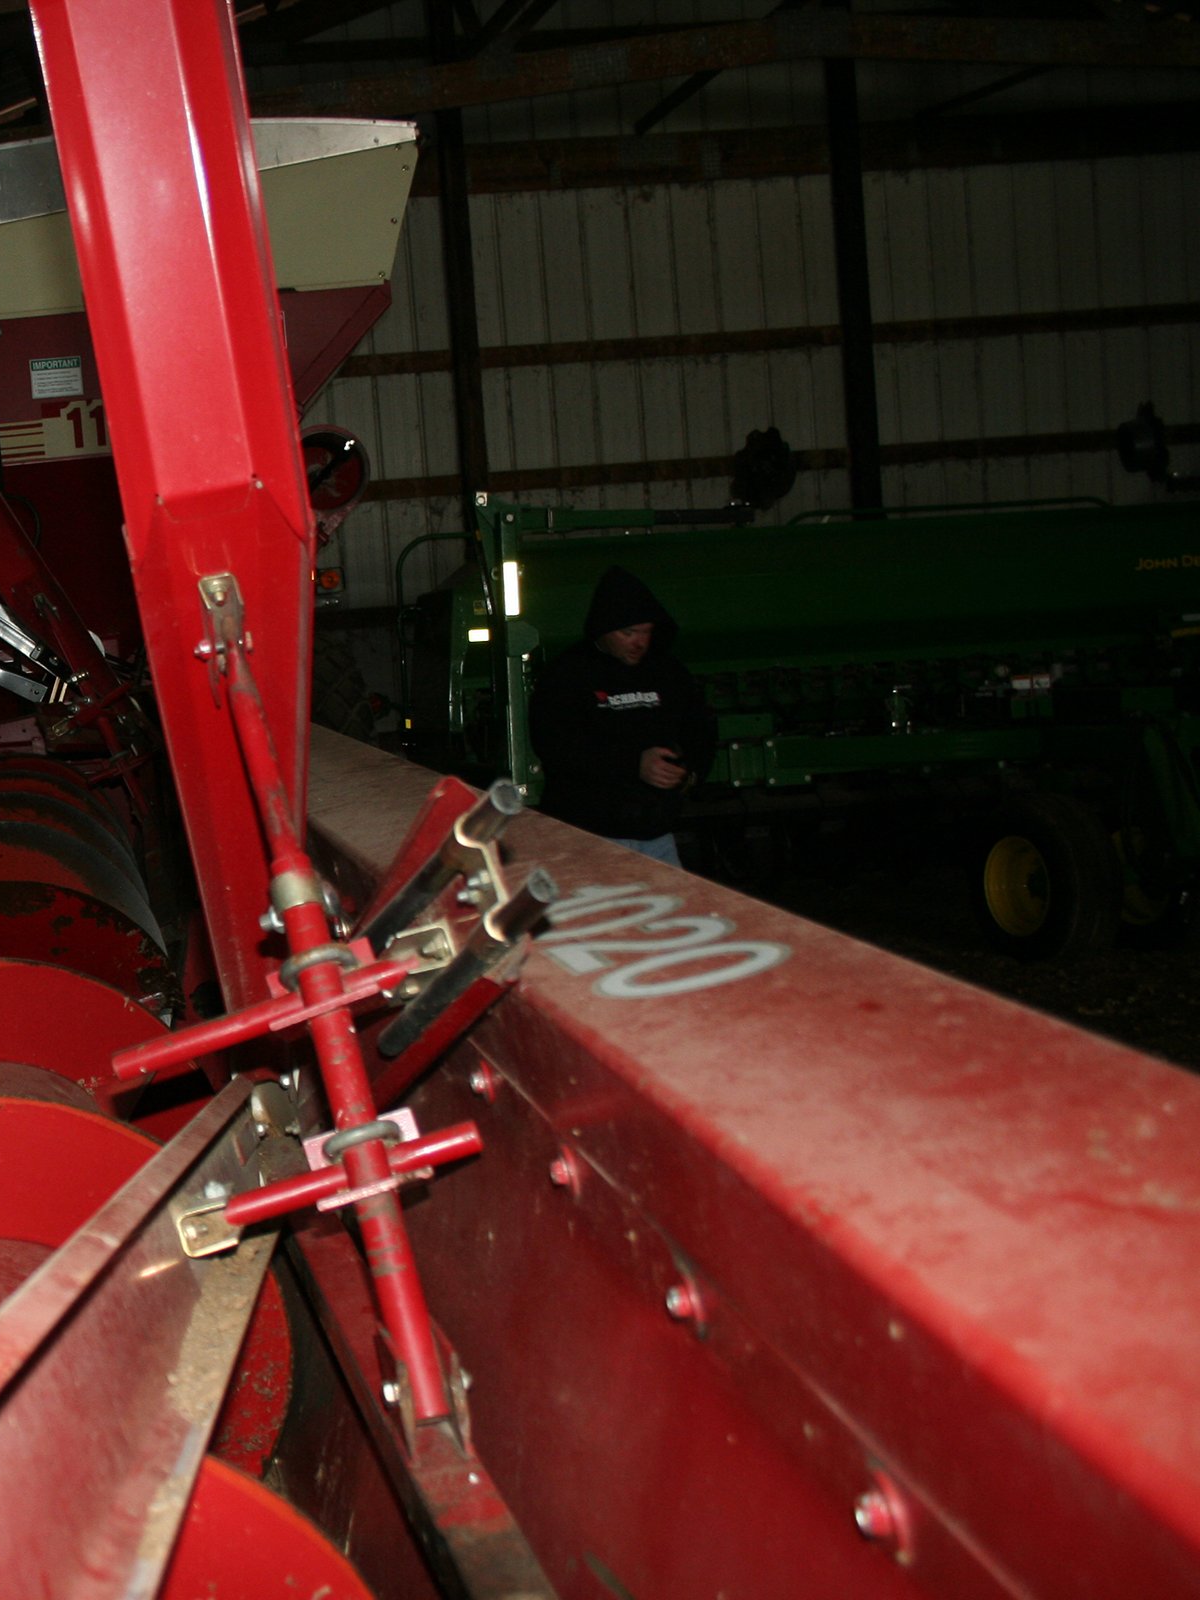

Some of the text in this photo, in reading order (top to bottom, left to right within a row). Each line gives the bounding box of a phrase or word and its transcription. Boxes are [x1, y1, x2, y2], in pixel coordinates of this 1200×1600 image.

[32, 358, 79, 370] IMPORTANT
[1135, 556, 1179, 571] JOHN
[533, 882, 794, 999] 1020
